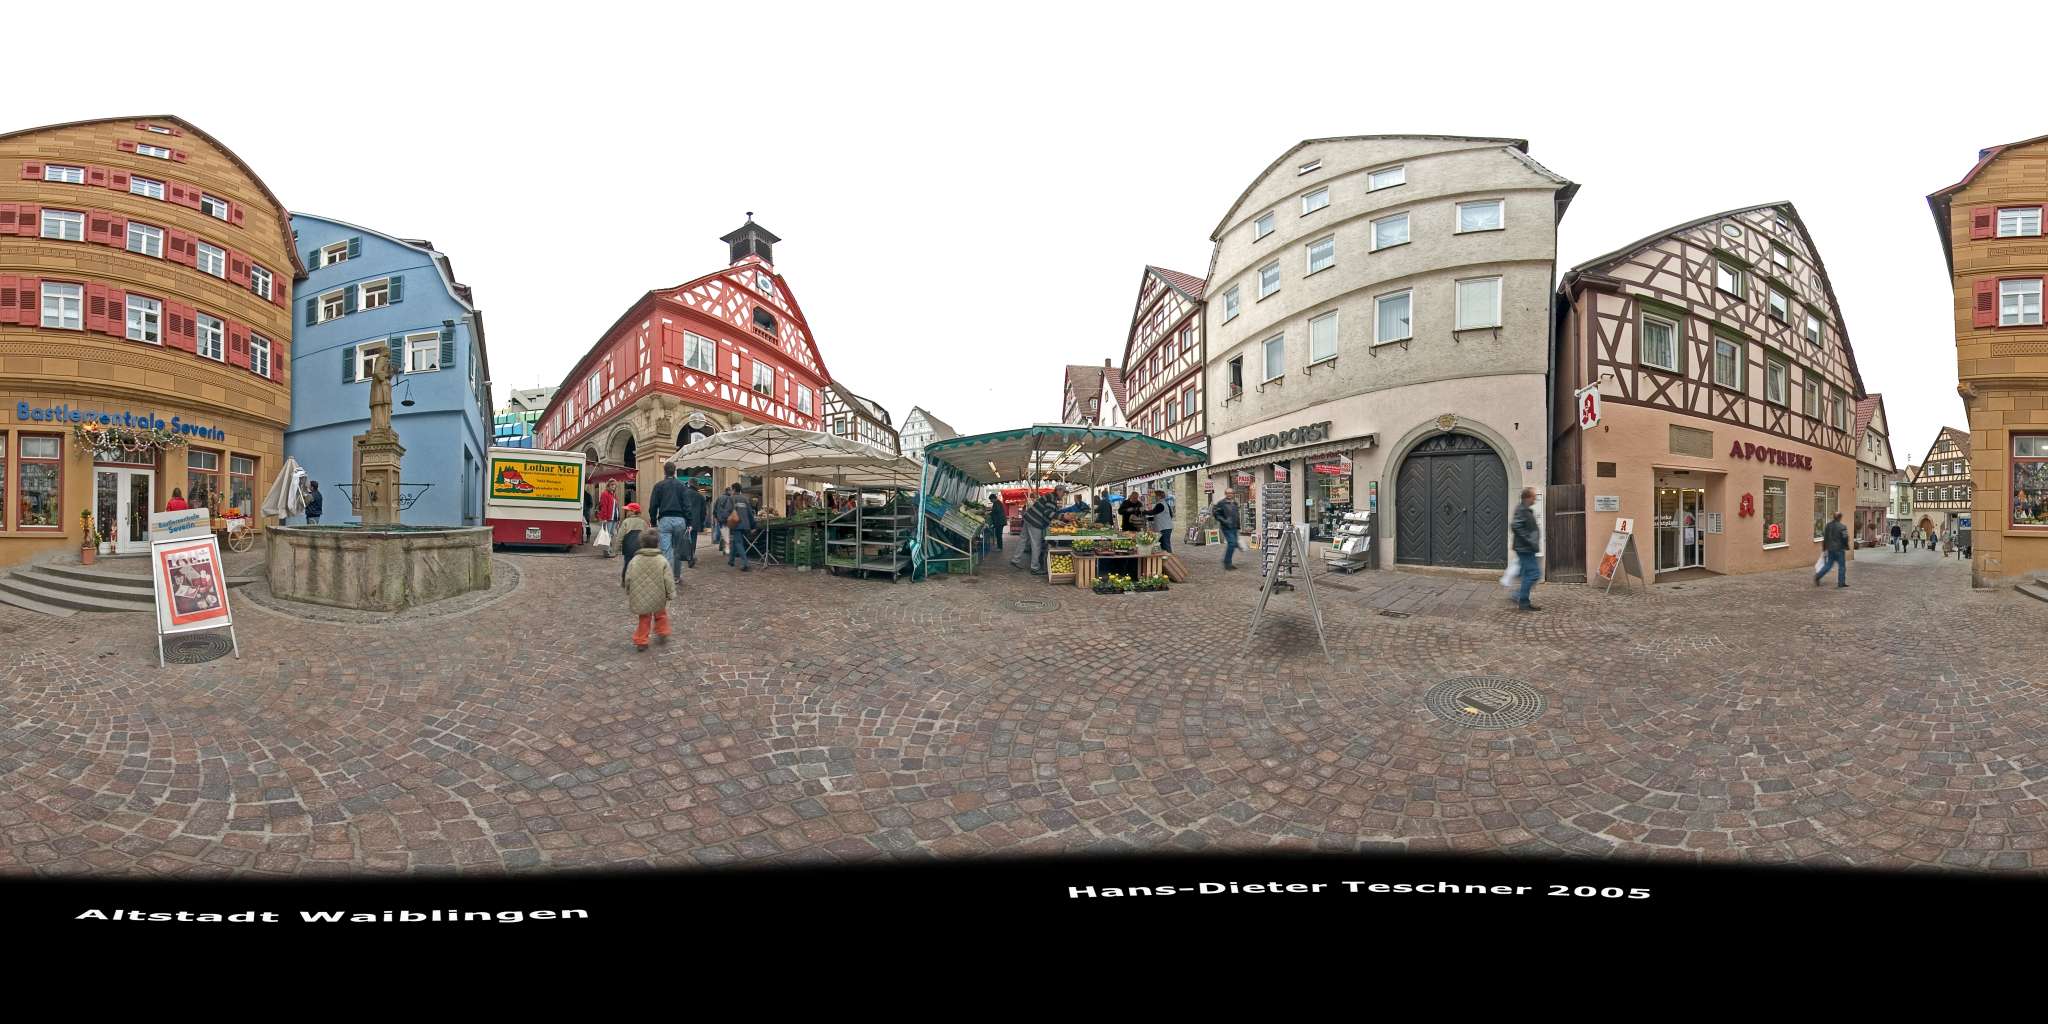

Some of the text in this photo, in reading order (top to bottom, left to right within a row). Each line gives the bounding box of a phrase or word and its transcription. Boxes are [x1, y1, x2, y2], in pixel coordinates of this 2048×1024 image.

[171, 416, 225, 441] Severin
[1237, 420, 1333, 456] PHOTO PORST
[1729, 439, 1813, 471] APOTHEKE
[523, 463, 555, 473] Lothar
[168, 522, 195, 534] Severin
